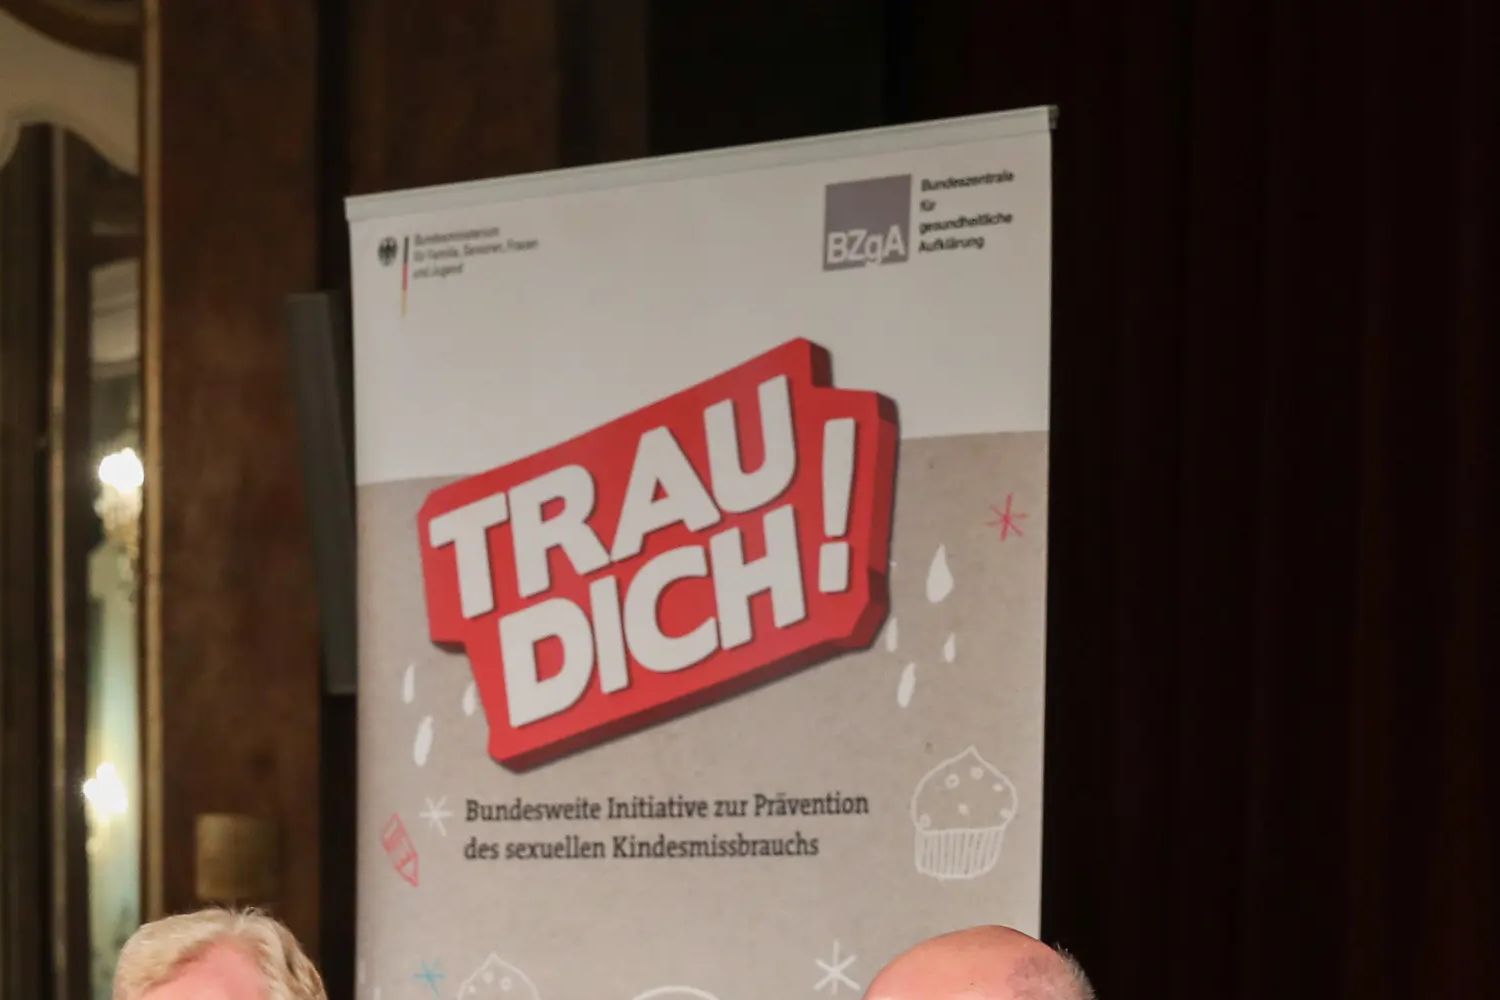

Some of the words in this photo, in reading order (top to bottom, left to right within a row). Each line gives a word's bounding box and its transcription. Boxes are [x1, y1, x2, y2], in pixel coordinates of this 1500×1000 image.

[920, 169, 1015, 192] Bundeszentrale
[919, 199, 937, 212] für
[918, 212, 1014, 235] gesundheitliche
[826, 224, 905, 267] BZgA
[917, 236, 985, 253] Aufklärung
[428, 373, 797, 620] TRAU
[465, 797, 601, 822] Bundesweite
[607, 795, 708, 820] Initiative
[713, 798, 748, 818] zur
[753, 791, 869, 817] Prävention
[464, 837, 499, 860] des
[505, 835, 607, 859] sexuellen
[611, 832, 819, 858] Kindesmissbrauchs
